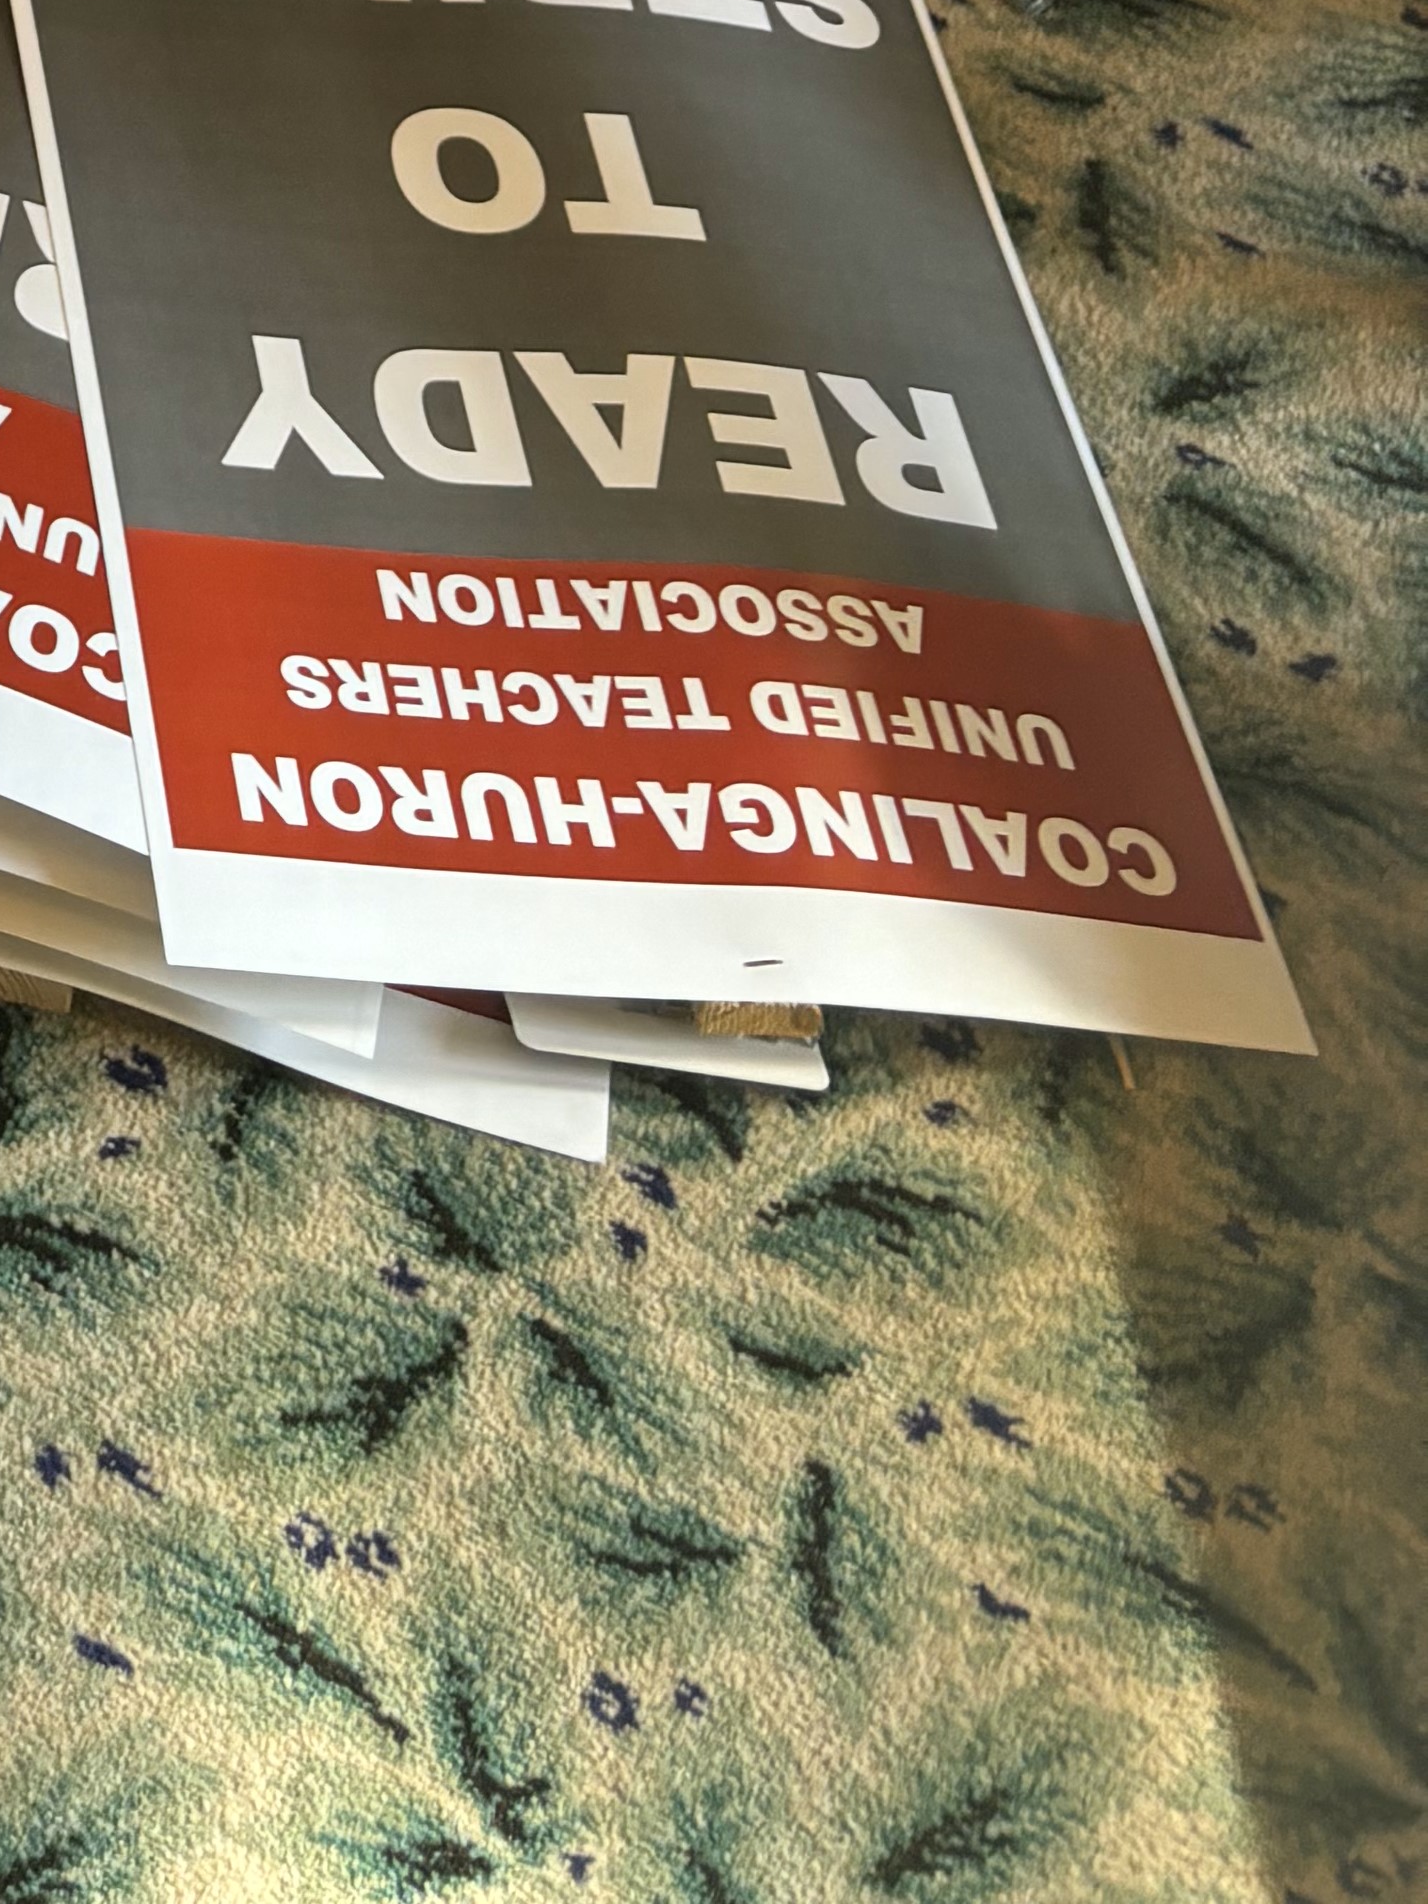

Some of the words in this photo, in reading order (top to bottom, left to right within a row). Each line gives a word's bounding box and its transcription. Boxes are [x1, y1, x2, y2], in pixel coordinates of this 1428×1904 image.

[390, 107, 706, 242] TO
[222, 334, 997, 531] READY
[376, 568, 924, 655] ASSOCIATION
[280, 654, 730, 733] TEACHERS
[749, 679, 1075, 771] UNIFIED
[229, 751, 1177, 896] COALINGA-HURON
